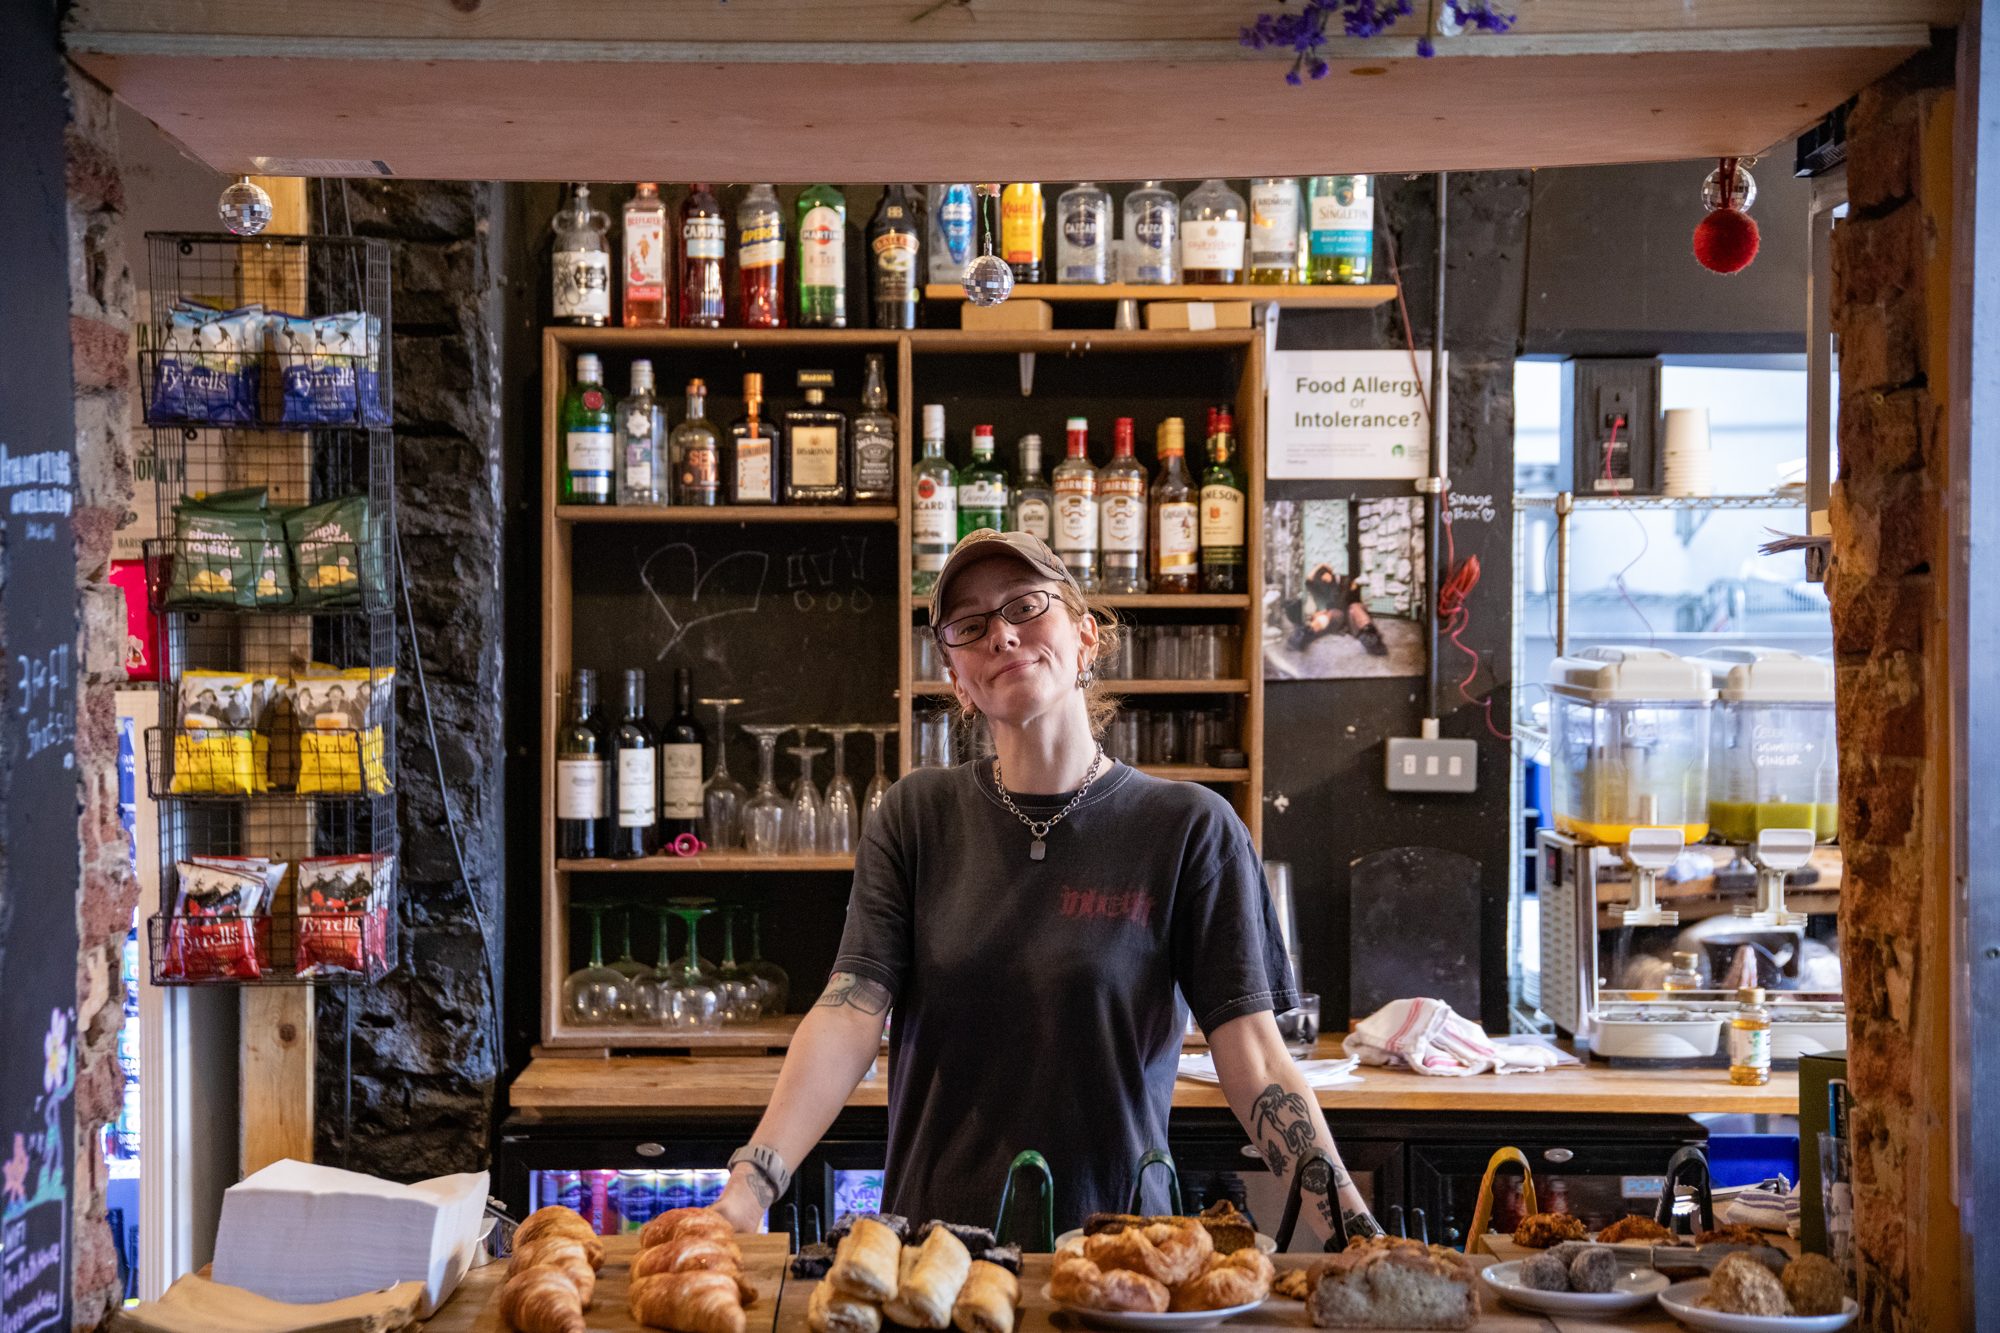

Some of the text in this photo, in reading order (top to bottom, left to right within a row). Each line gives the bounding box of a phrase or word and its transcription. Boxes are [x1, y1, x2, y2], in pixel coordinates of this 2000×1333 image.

[1296, 377, 1423, 397] Food Allergy
[1350, 398, 1366, 408] or
[1295, 411, 1421, 428] Intolerance?
[187, 541, 243, 559] roasted.
